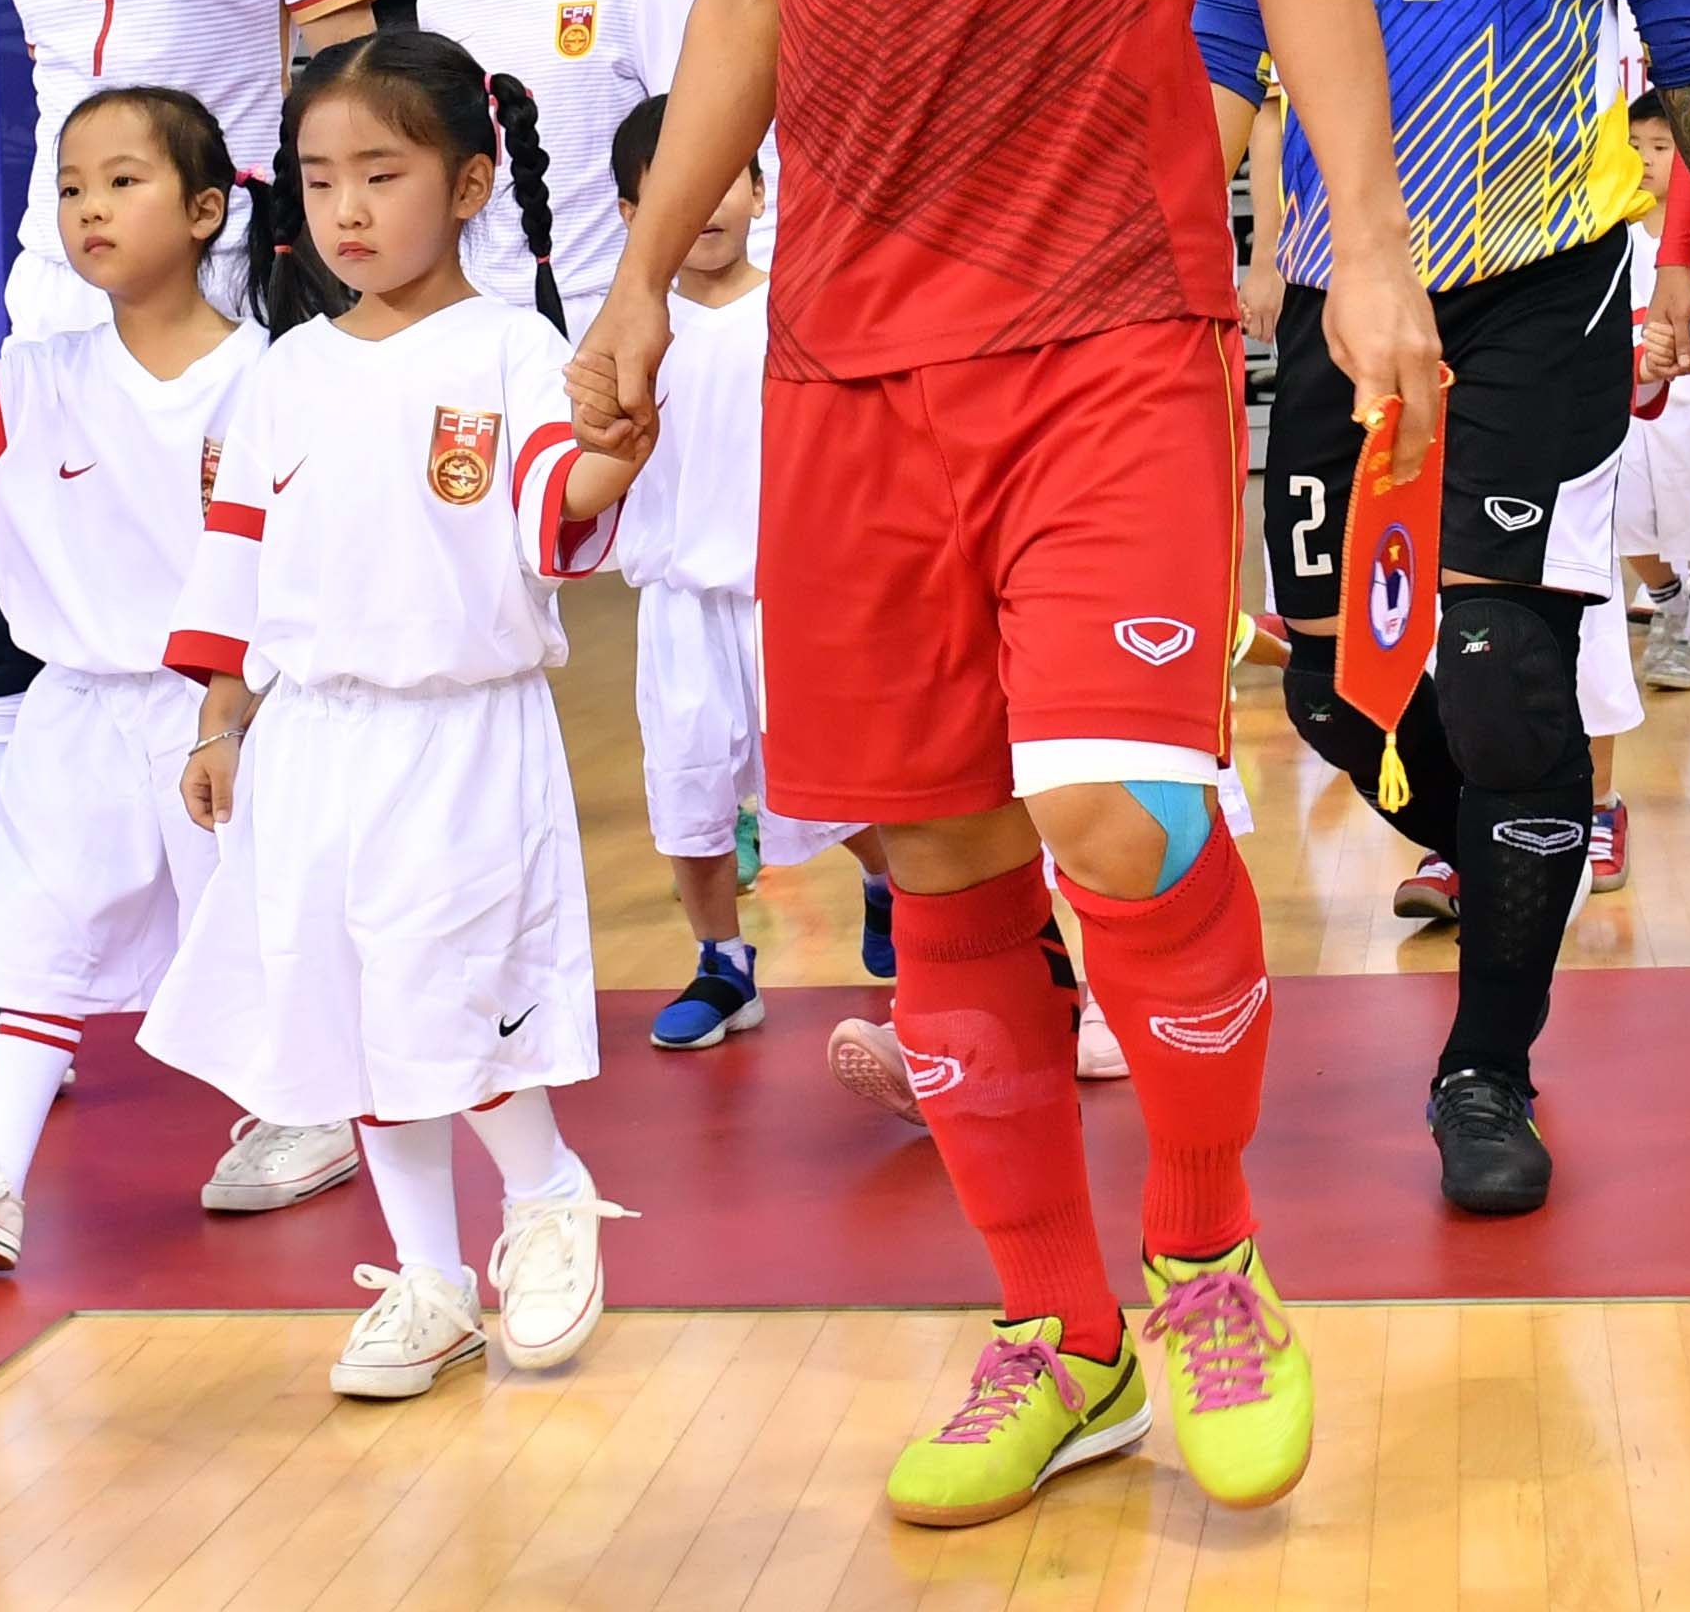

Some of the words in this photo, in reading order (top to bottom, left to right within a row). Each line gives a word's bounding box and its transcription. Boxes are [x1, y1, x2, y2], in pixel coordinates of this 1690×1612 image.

[563, 6, 593, 19] CFA
[440, 412, 495, 436] CFA
[1288, 474, 1334, 577] 2
